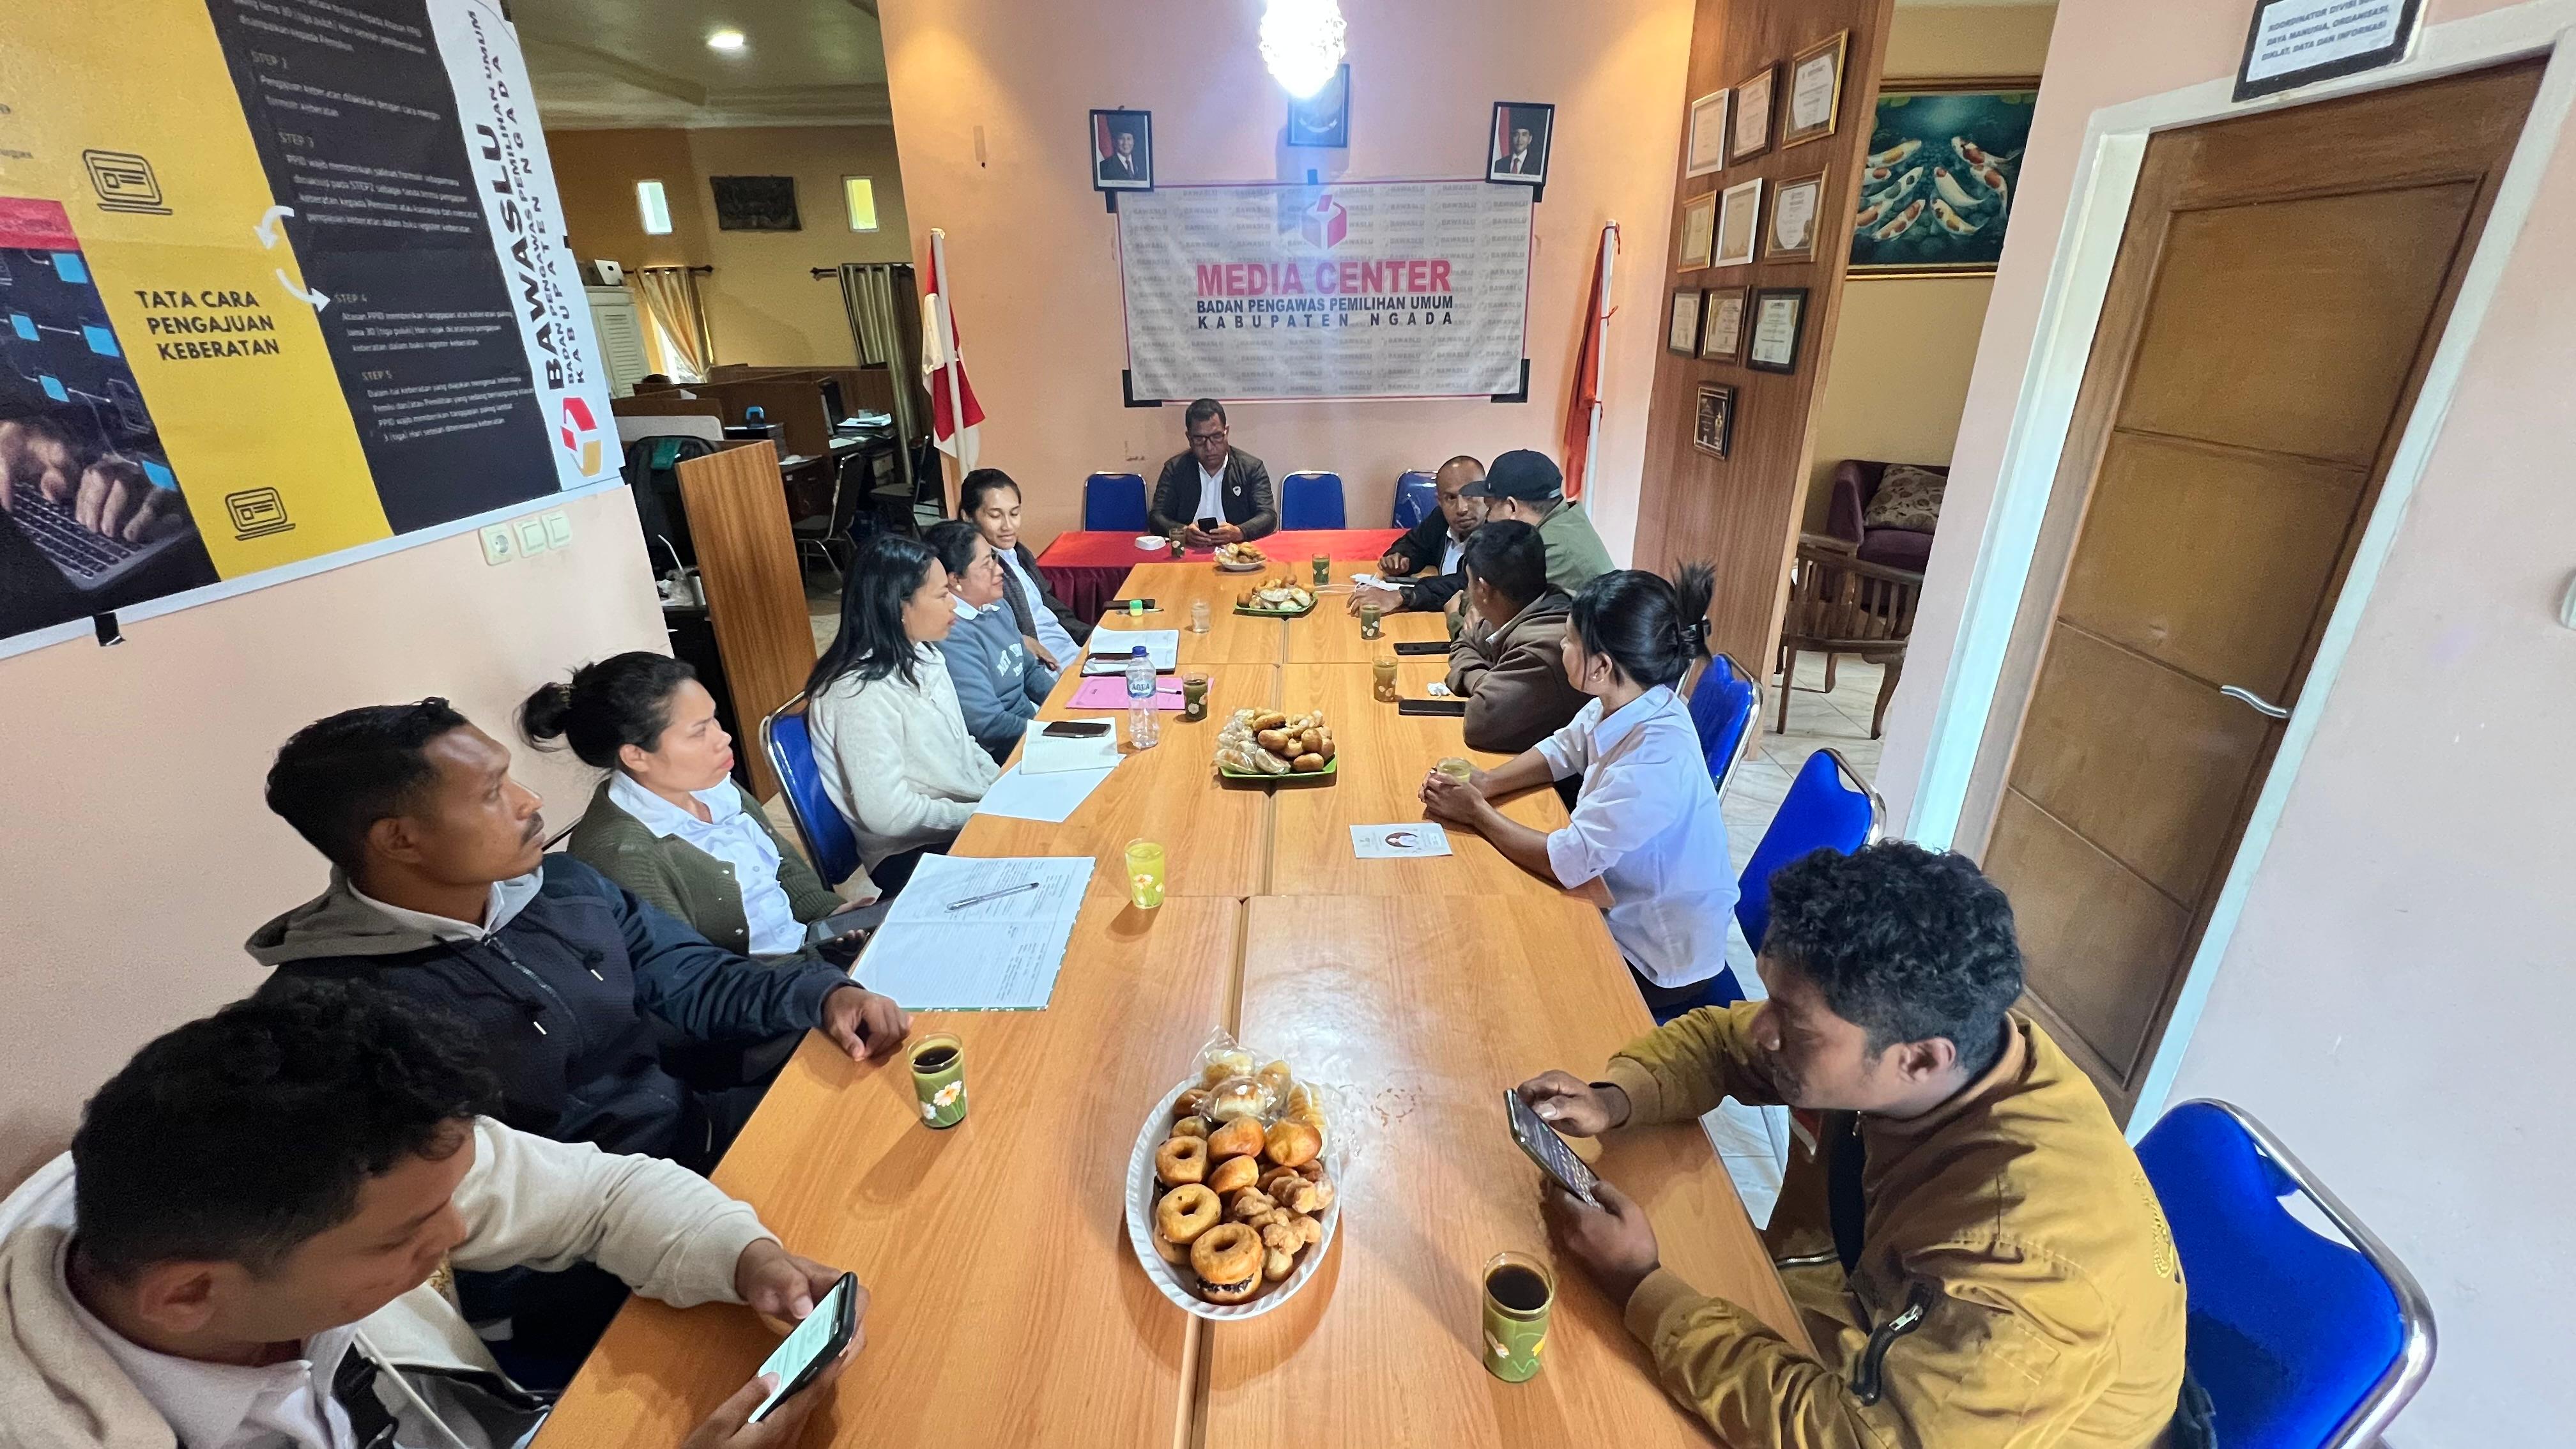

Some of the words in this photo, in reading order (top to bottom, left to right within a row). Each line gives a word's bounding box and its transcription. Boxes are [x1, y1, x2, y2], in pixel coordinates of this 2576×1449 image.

[468, 10, 492, 80] UMUM
[492, 56, 532, 174] NGADA
[489, 87, 528, 202] PEMILIHAN
[476, 123, 565, 390] BAWASLU
[525, 208, 558, 317] PENGAWAS
[532, 196, 585, 383] KABUPATEN
[1197, 262, 1305, 296] MEDIA
[1314, 259, 1452, 295] CENTER
[134, 290, 196, 309] TATA
[201, 290, 260, 308] CARA
[334, 293, 359, 303] STEP
[1197, 300, 1243, 313] BADAN
[1248, 298, 1325, 312] PENGAWAS
[1330, 297, 1406, 311] PEMILIHAN
[1410, 296, 1453, 310] UMUM
[146, 316, 275, 335] PENGAJUAN
[1198, 314, 1349, 330] KABUPATEN
[1370, 312, 1452, 326] NGADA
[157, 339, 280, 361] KEBERATAN
[556, 323, 574, 384] BADAN
[362, 371, 384, 381] STEP
